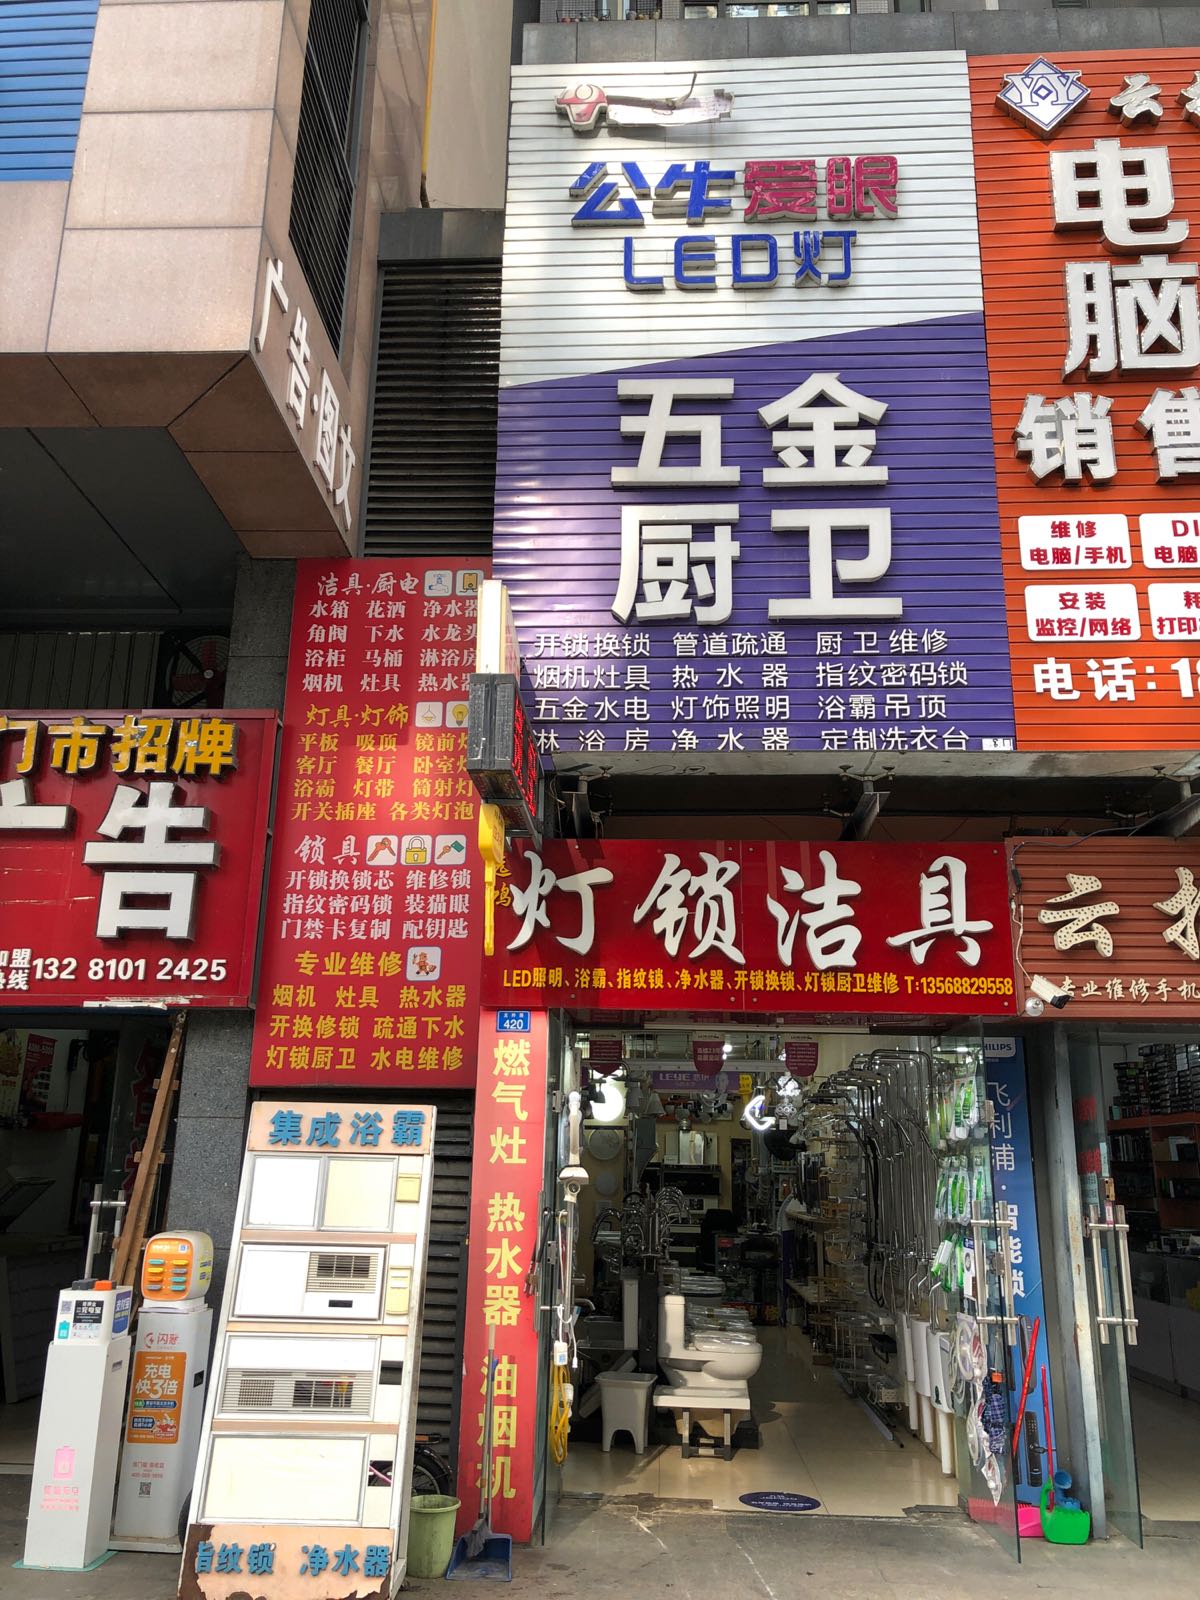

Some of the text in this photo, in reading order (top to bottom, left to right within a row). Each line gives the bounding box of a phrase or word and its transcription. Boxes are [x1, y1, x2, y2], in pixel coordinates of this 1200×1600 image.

[569, 155, 899, 226] 公牛爱眼
[624, 230, 857, 290] LED灯
[611, 372, 889, 487] 五金
[1050, 520, 1097, 538] 维修
[611, 503, 903, 625] 厨卫
[1030, 545, 1127, 565] 电脑/手机
[308, 600, 349, 619] 水箱
[366, 600, 406, 619] 花洒
[1058, 591, 1106, 610] 安装
[307, 624, 347, 643] 角阀
[364, 624, 404, 643] 下水
[1035, 617, 1132, 637] 监控/网络
[1157, 617, 1200, 636] 打印
[534, 632, 650, 658] 开锁换锁
[672, 631, 788, 657] 管道疏通
[816, 628, 948, 655] 厨卫维修
[305, 649, 346, 668] 浴柜
[362, 649, 403, 668] 马桶
[302, 673, 343, 693] 烟机
[360, 673, 401, 693] 灶具
[533, 660, 968, 690] 烟机灶具 热水器 指纹密码锁
[534, 693, 947, 721] 五金水电 灯饰照明 浴霸吊顶
[298, 732, 340, 752] 平板
[356, 732, 398, 752] 吸顶
[672, 726, 790, 751] 净水器
[821, 725, 970, 750] 定制洗衣台
[296, 756, 337, 775] 客厅
[355, 756, 396, 775] 餐厅
[294, 777, 473, 798] 浴霸 灯带 筒射灯
[291, 801, 475, 821] 开关插座 各类灯泡
[294, 835, 361, 865] 锁具
[285, 869, 471, 891] 开锁换锁芯 维修锁
[283, 893, 470, 915] 指纹密码锁 装猫眼
[507, 848, 994, 972] 灯锁洁具
[281, 917, 469, 940] 门禁卡复制 配钥匙
[33, 958, 227, 981] 132 8101 2425
[295, 950, 402, 977] 专业维修
[272, 984, 466, 1008] 烟机 灶具 热水器
[904, 976, 1013, 995] T:13568829558
[269, 1015, 465, 1040] 开换修锁 疏通下水
[503, 1019, 524, 1030] 420
[266, 1045, 464, 1071] 灯锁厨卫 水电维修
[489, 1039, 531, 1165] 燃气灶
[269, 1109, 426, 1148] 集成浴霸
[482, 1191, 526, 1327] 热水器
[144, 1364, 172, 1378] 充电
[136, 1378, 178, 1399] 快3倍
[300, 1543, 390, 1578] 净水器
